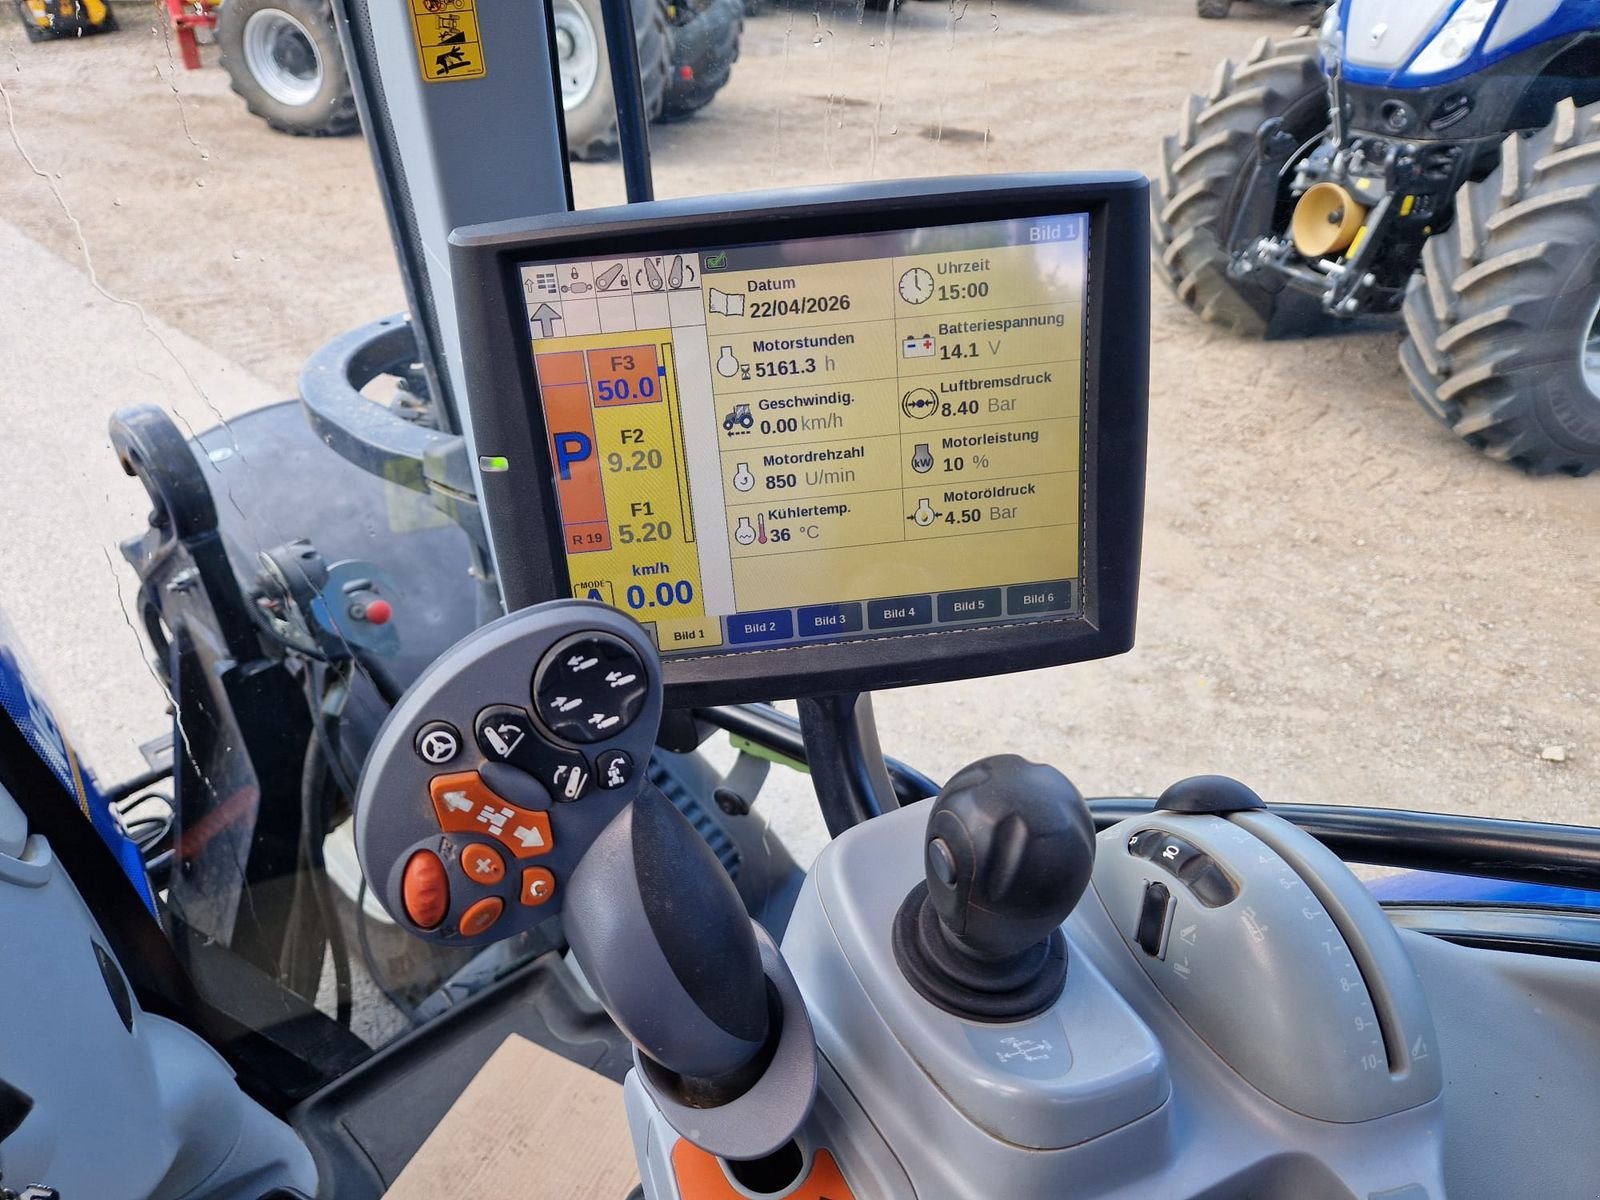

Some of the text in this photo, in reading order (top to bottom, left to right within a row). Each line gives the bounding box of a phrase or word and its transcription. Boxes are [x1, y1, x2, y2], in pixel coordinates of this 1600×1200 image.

[1029, 223, 1076, 242] Bild 1
[937, 258, 991, 275] Uhrzeit
[747, 278, 796, 292] Datum
[938, 282, 989, 301] 15:00
[750, 294, 850, 318] 22/04/2026
[939, 313, 1064, 335] Batteriespannung
[753, 333, 855, 353] Motorstunden
[940, 340, 1001, 360] 14.1 V
[611, 355, 635, 372] F3
[755, 355, 835, 378] 5161.3 h
[597, 377, 654, 401] 50.0
[940, 371, 1052, 393] Luftbremsdruck
[758, 391, 855, 410] Geschwindig.
[941, 398, 1016, 417] 8.40 Bar
[760, 413, 843, 435] 0.00 km/h
[620, 429, 645, 444] F2
[942, 430, 1039, 449] Motorleistung
[553, 431, 592, 480] P
[607, 449, 662, 472] 9.20
[763, 446, 865, 467] Motordrehzahl
[914, 457, 931, 468] kW
[943, 454, 989, 472] 10 %
[765, 467, 855, 490] 850 U/min
[944, 483, 1035, 502] Motoröldruck
[631, 502, 654, 517] F1
[768, 503, 851, 521] Kühlertemp.
[945, 506, 1018, 524] 4.50 Bar
[572, 533, 603, 545] R 19
[618, 521, 672, 544] 5.20
[770, 525, 820, 543] 36 °C
[632, 562, 669, 576] km/h
[580, 580, 605, 589] MODE
[627, 580, 693, 609] 0.00
[1023, 593, 1054, 605] Bild 6
[884, 607, 916, 619] Bild 4
[954, 600, 985, 612] Bild 5
[744, 622, 776, 634] Bild 2
[815, 615, 846, 626] Bild 3
[674, 629, 705, 641] Bild 1
[1163, 845, 1180, 860] 10
[1302, 908, 1313, 920] 6
[1340, 977, 1350, 992] 8
[1354, 1017, 1364, 1031] 9
[1361, 1054, 1377, 1071] 10
